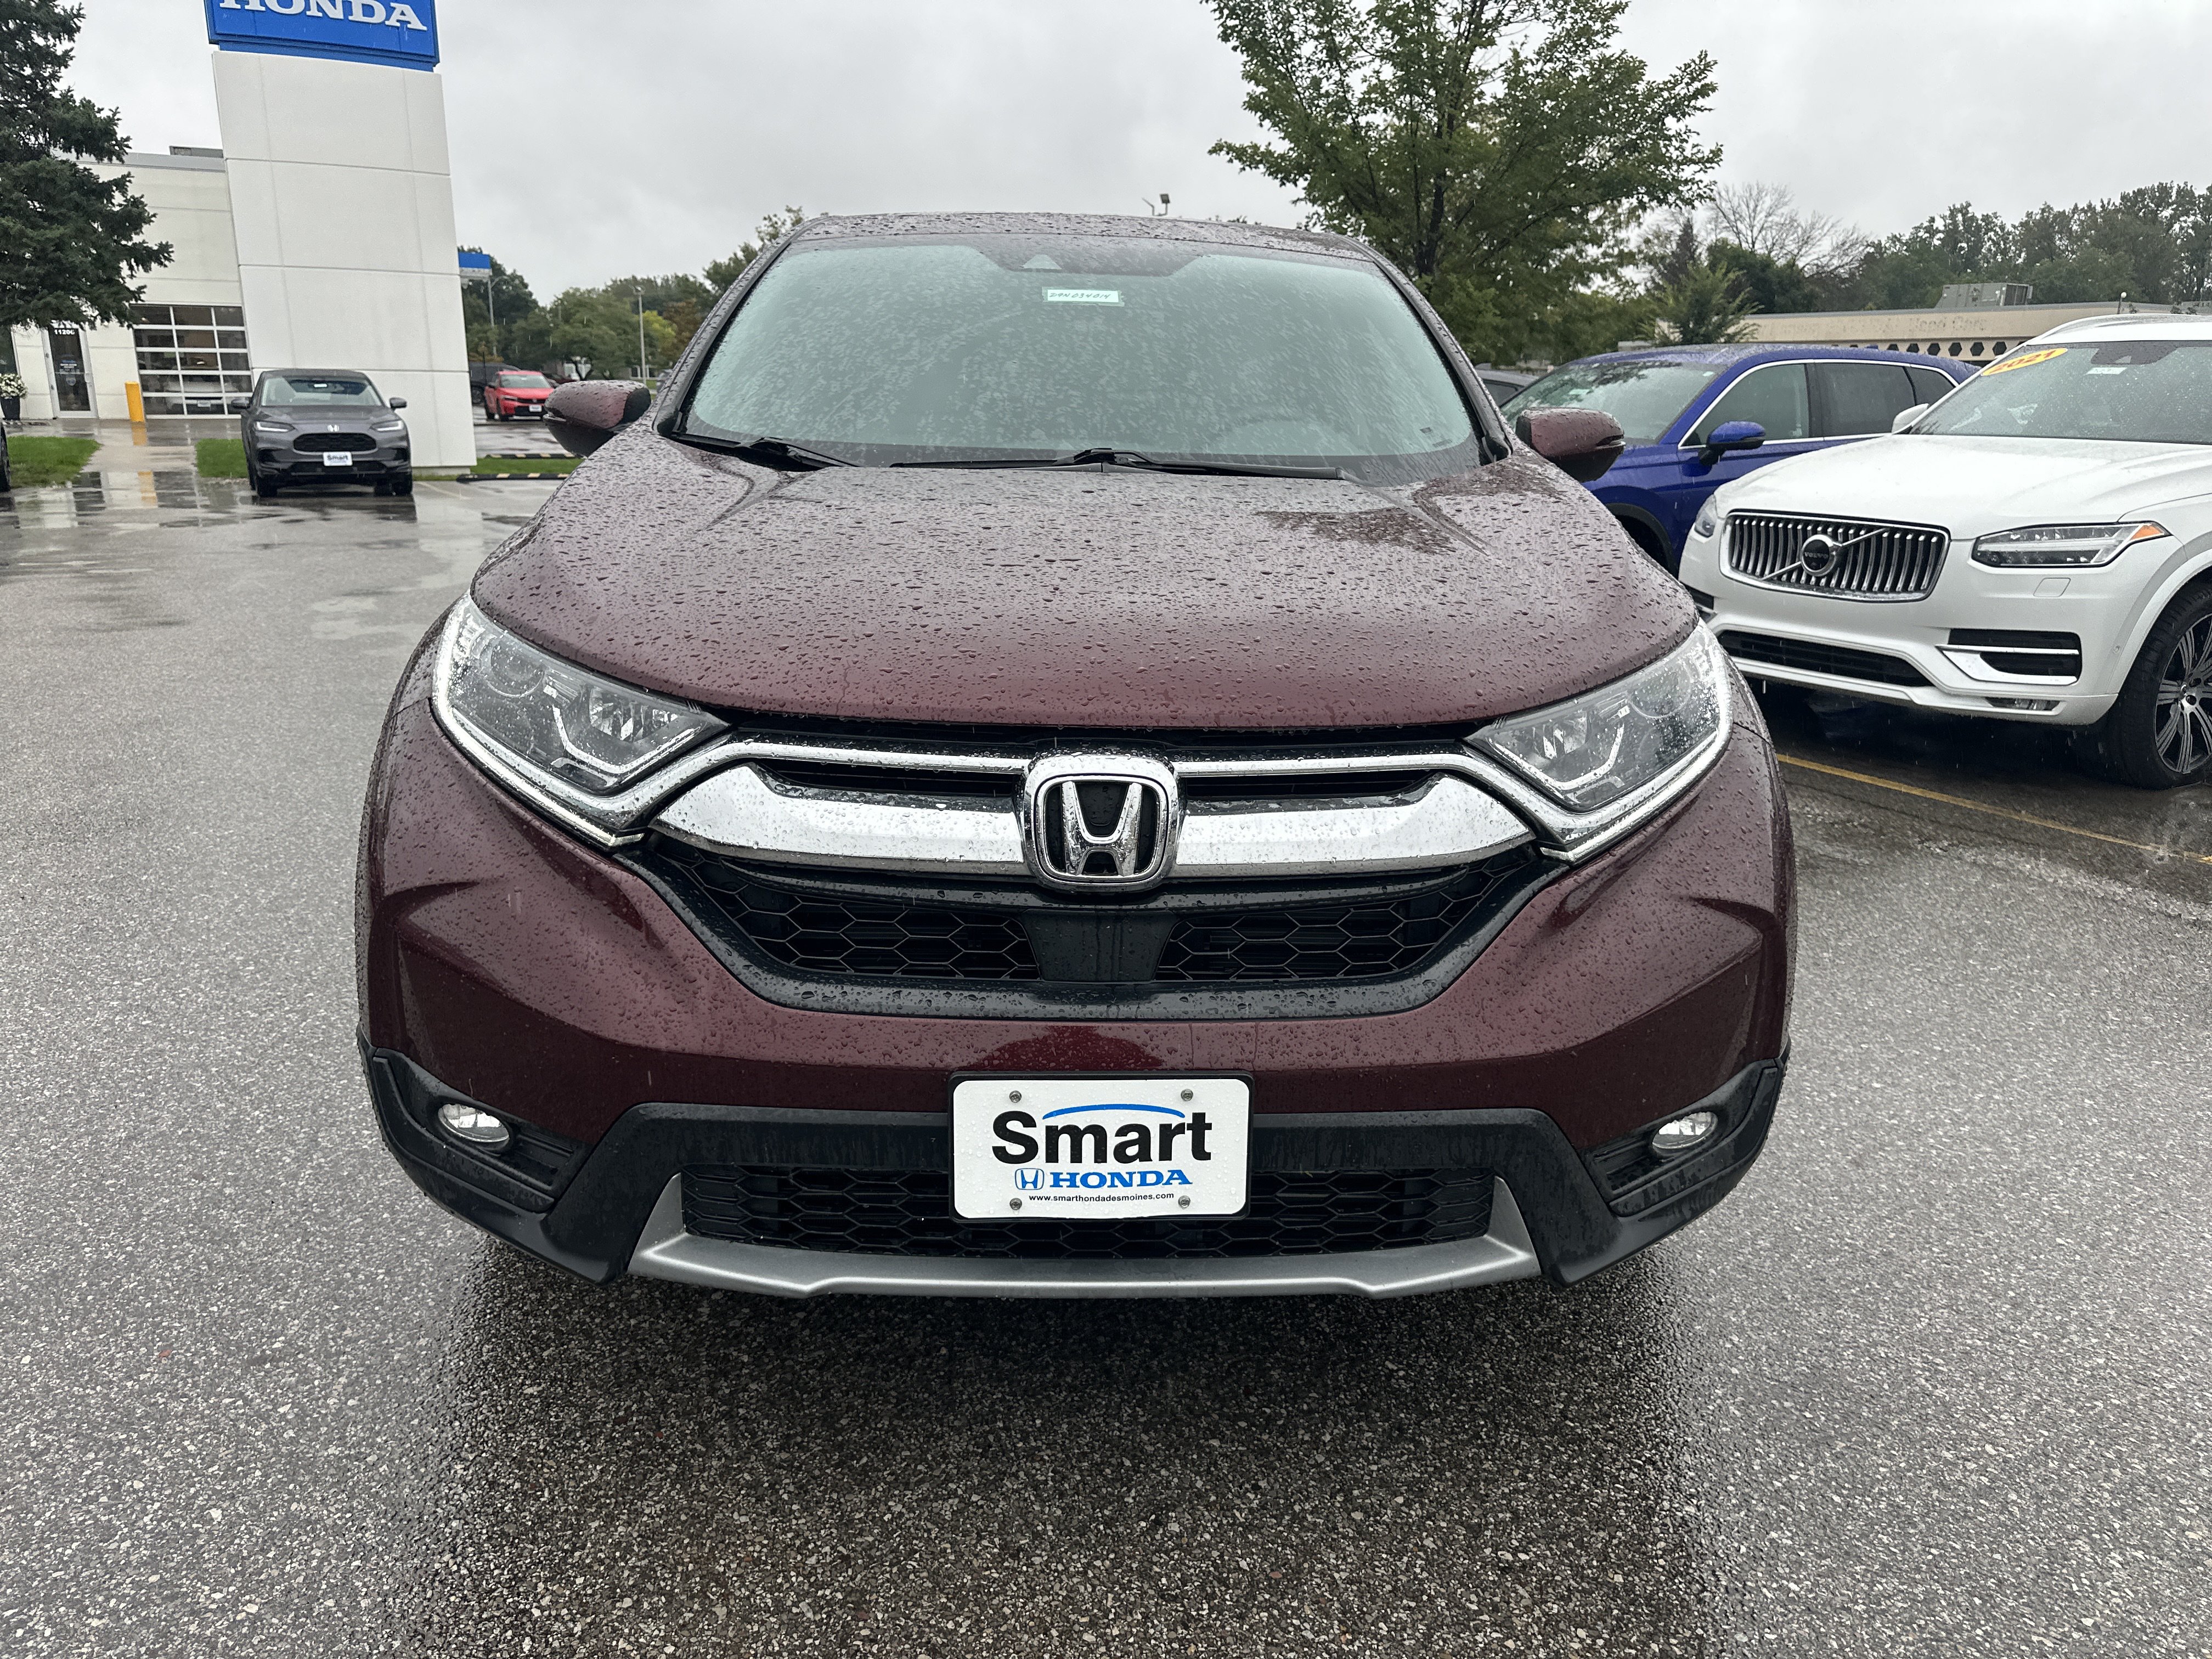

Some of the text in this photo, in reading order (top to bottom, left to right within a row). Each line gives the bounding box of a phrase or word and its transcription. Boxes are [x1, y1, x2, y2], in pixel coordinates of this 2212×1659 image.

[1988, 350, 2056, 374] 2021
[992, 1110, 1212, 1164] Smart
[1049, 1169, 1193, 1189] HONDA
[1029, 1192, 1175, 1203] www.smarthondadesmoines.com
